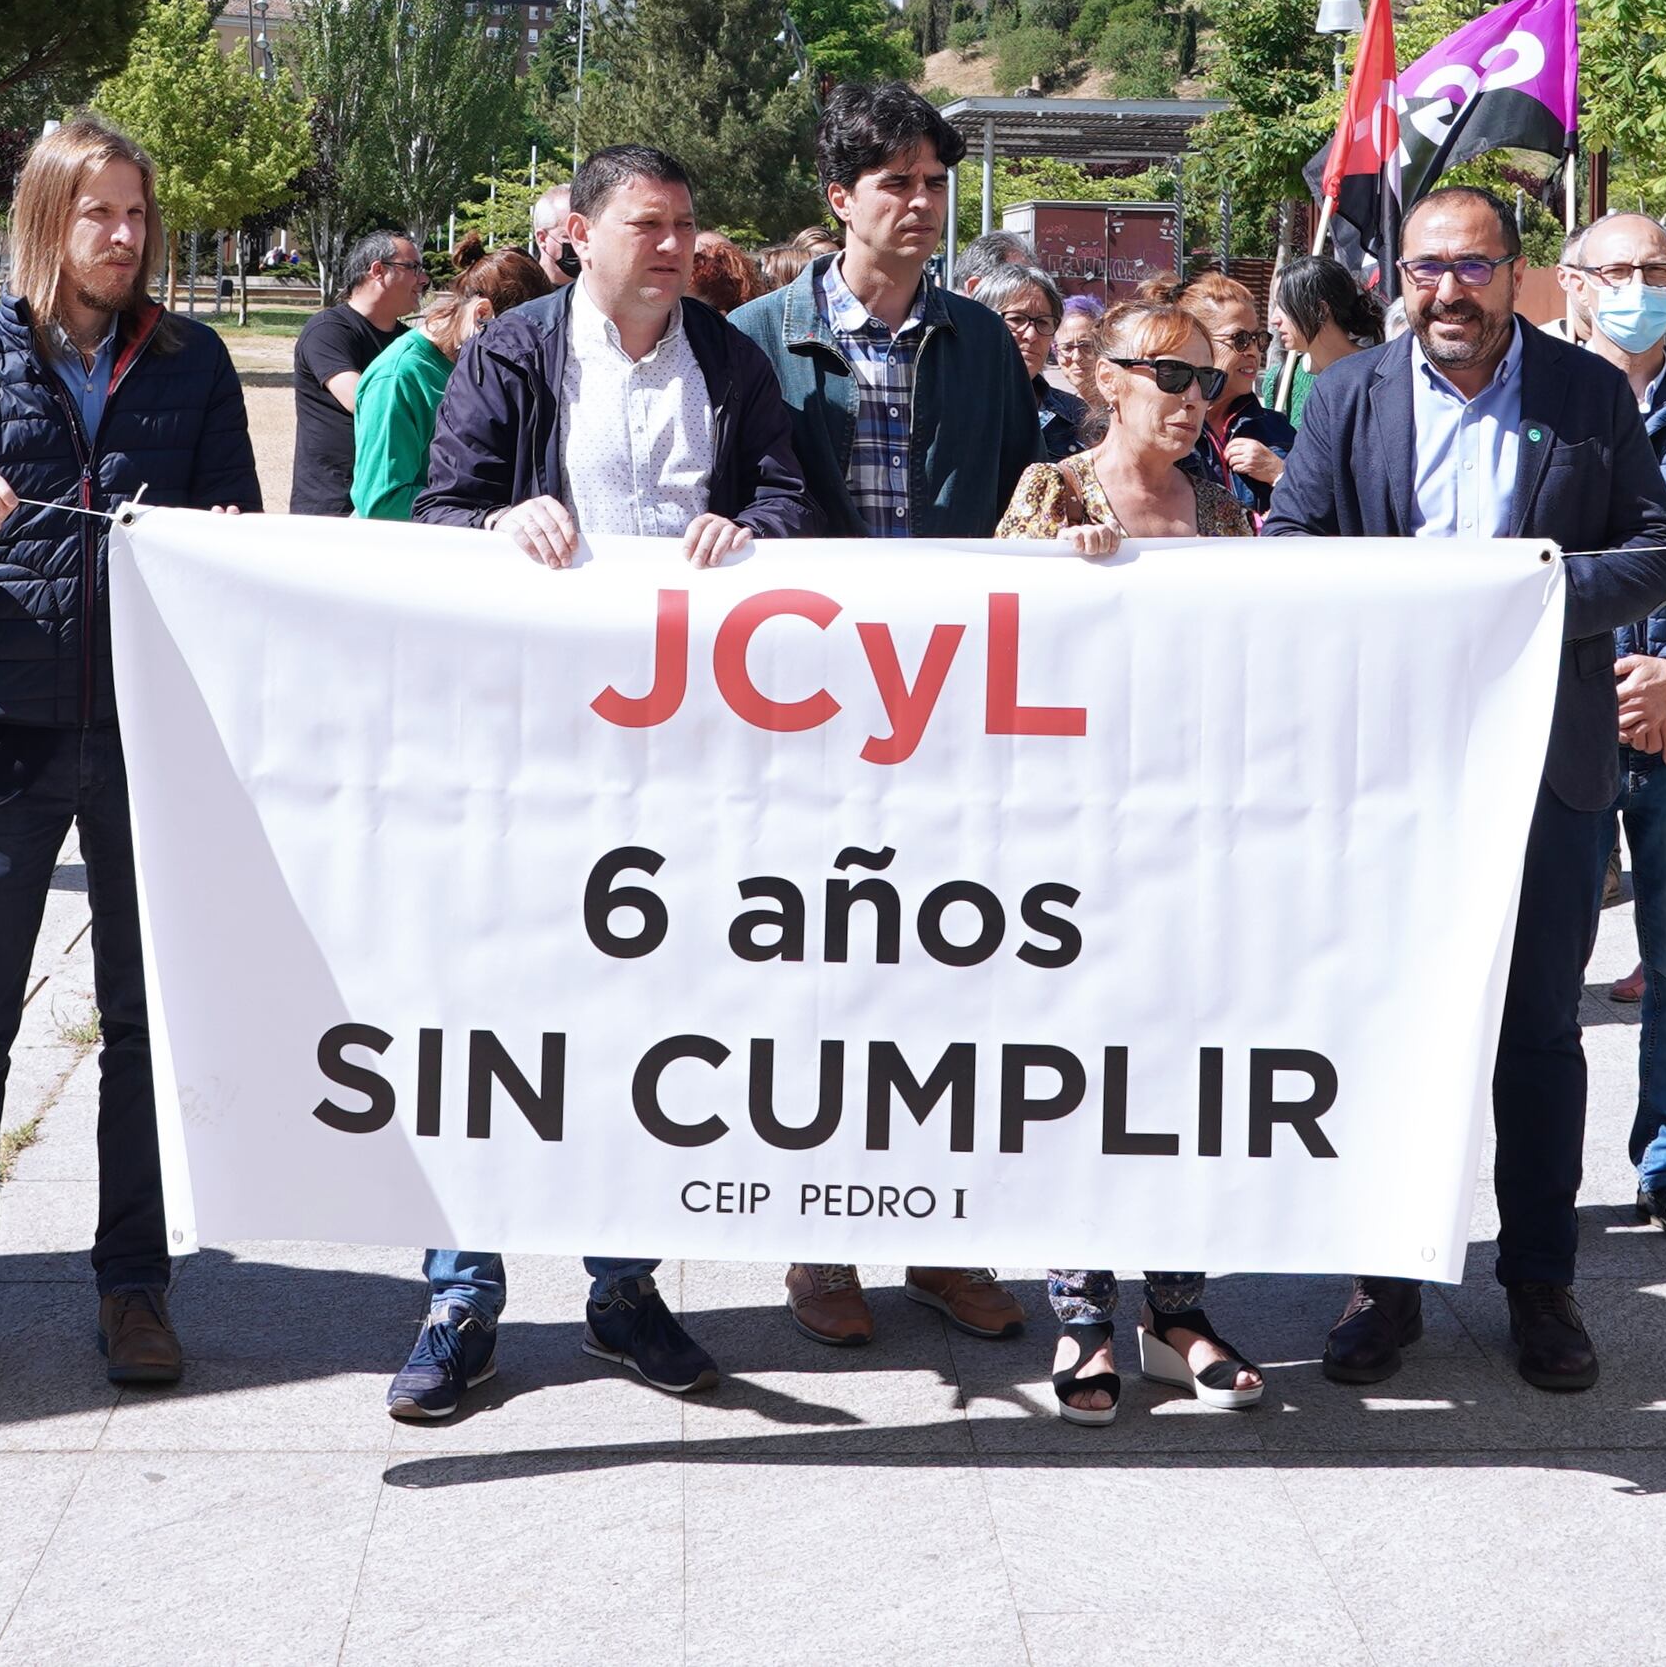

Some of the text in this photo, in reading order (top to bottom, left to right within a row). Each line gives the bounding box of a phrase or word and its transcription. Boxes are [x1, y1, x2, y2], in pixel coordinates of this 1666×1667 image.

[590, 589, 1088, 765] JCyL
[583, 846, 1082, 969] 6 años
[312, 1022, 1340, 1158] SIN CUMPLIR
[681, 1180, 967, 1220] CEIP PEDRO I
